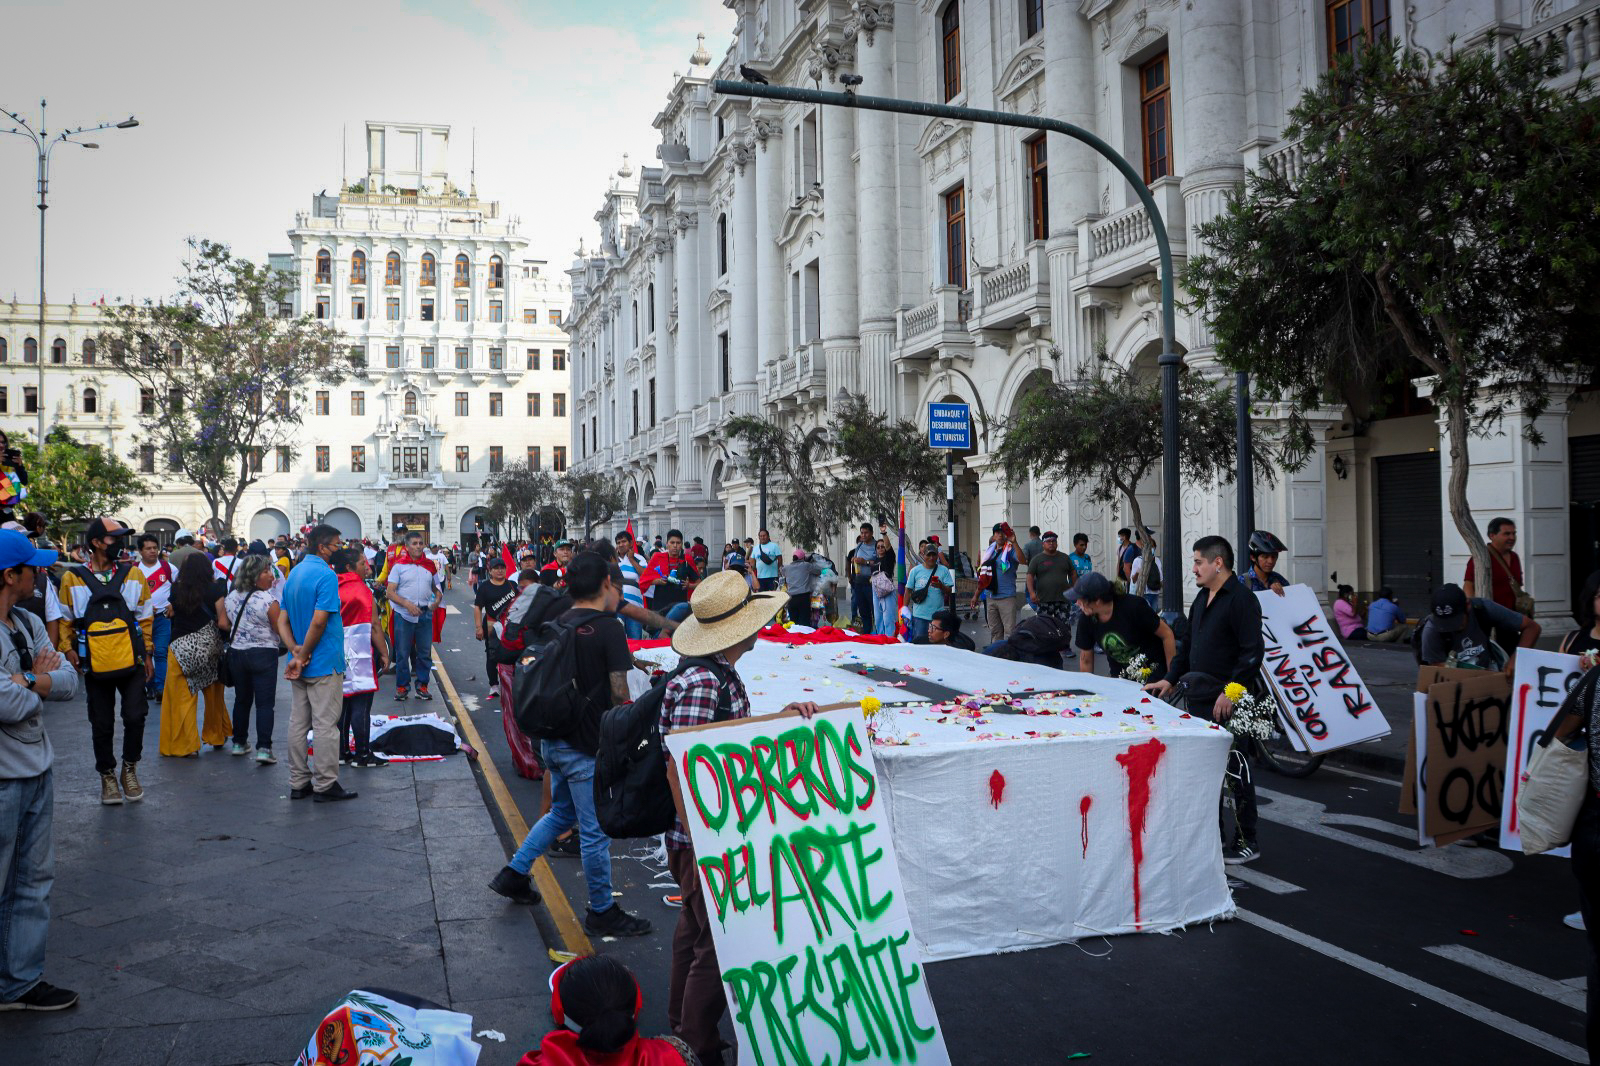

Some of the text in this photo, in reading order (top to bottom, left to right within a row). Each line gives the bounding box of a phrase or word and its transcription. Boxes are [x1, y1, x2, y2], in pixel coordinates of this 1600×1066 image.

[931, 421, 968, 430] DESEMBARQUE
[933, 409, 965, 418] EMBARQUE Y
[934, 433, 965, 442] DE TURISTAS
[1260, 615, 1329, 741] ORGANIZ
[684, 719, 876, 836] OBREROS
[698, 821, 894, 944] DEL ARTE
[721, 930, 936, 1066] PRESENTE
